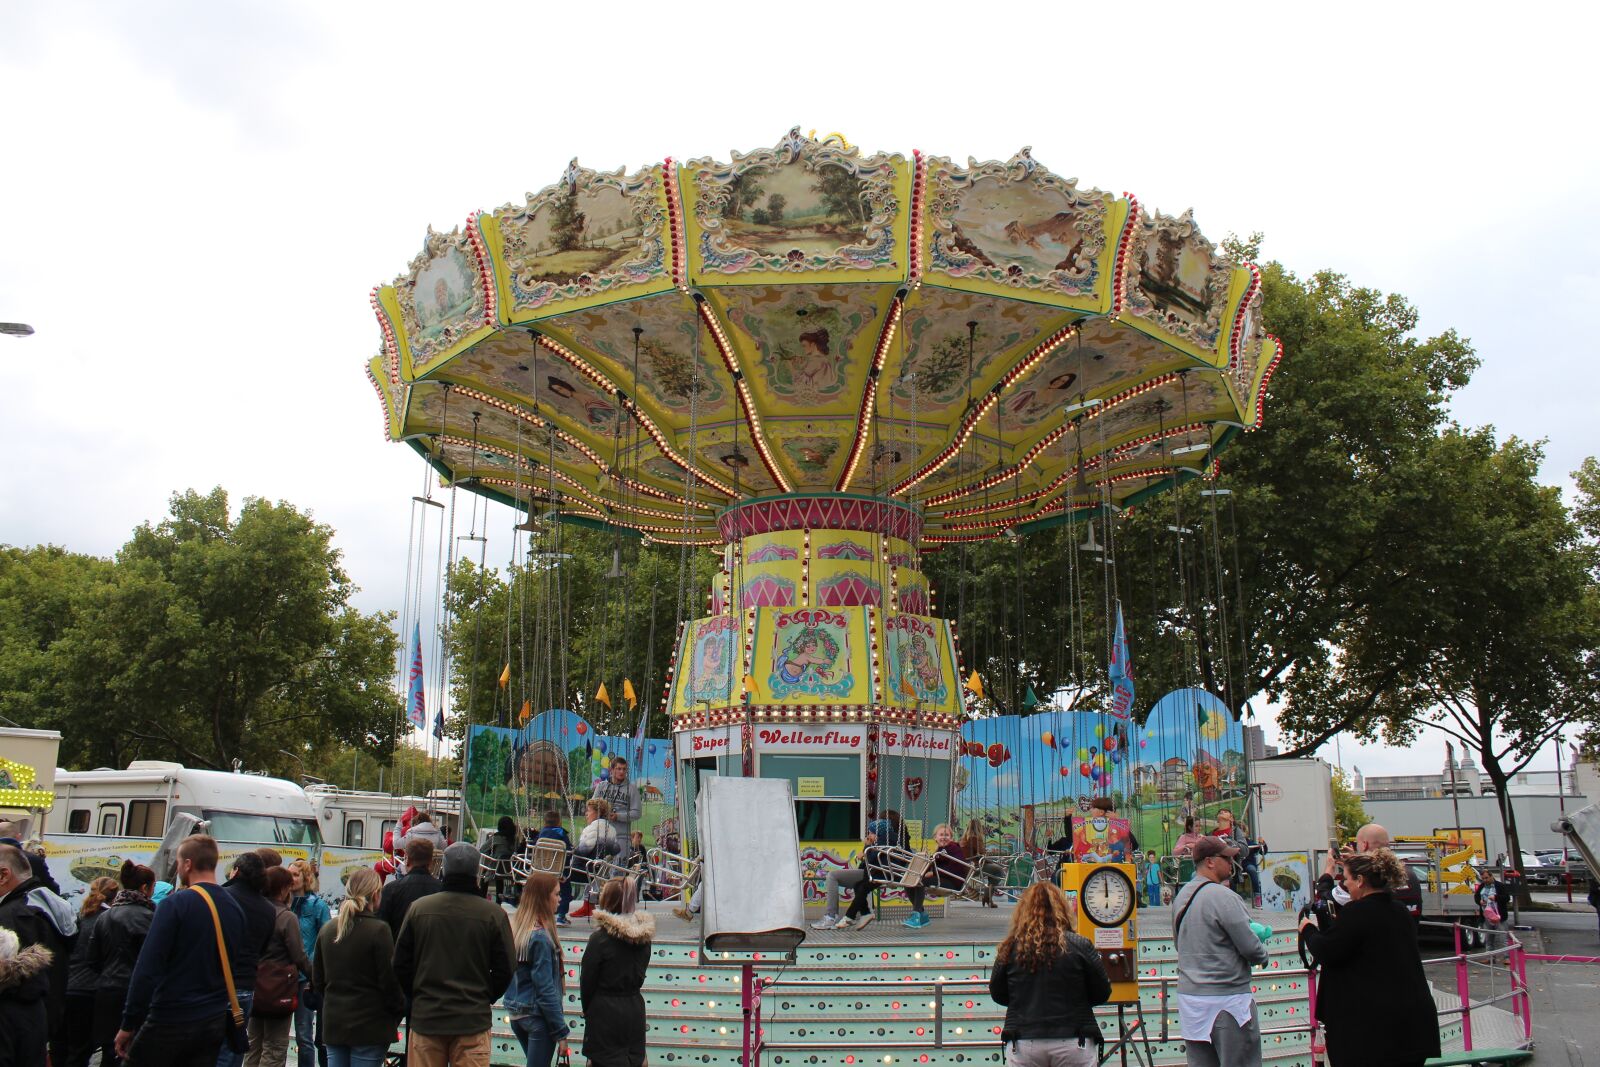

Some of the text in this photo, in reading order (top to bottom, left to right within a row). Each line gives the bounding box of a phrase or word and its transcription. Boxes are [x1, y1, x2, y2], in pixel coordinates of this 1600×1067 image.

[692, 736, 730, 750] Super
[759, 729, 861, 747] Wellenflug
[901, 733, 949, 750] Nickel
[959, 736, 1004, 768] ug
